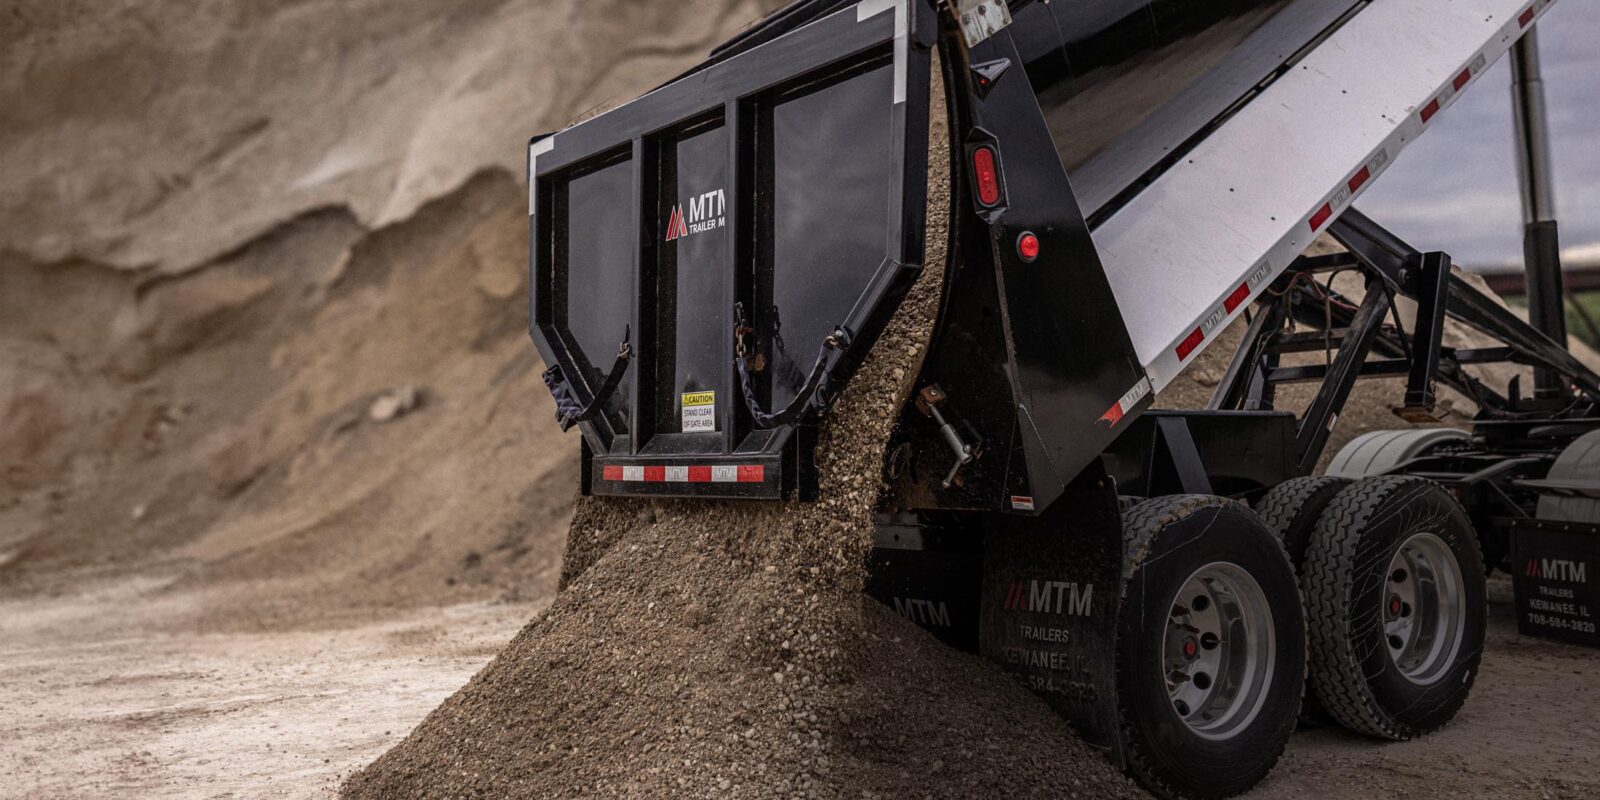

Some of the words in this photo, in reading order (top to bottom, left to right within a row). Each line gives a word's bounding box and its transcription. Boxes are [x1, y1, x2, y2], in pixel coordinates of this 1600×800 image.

[689, 219, 716, 235] TRAILER
[1205, 309, 1223, 331] MTM
[688, 394, 713, 404] CAUTION
[1125, 383, 1144, 406] MTM
[684, 408, 698, 417] STAND
[699, 407, 712, 416] CLEAR
[684, 420, 690, 428] OF
[690, 419, 701, 428] GATE
[702, 419, 713, 427] AREA
[1542, 557, 1586, 583] MTM
[1029, 579, 1094, 617] MTM
[1539, 585, 1574, 599] TRAILERS
[893, 596, 951, 627] MTM
[1019, 625, 1069, 643] TRAILERS
